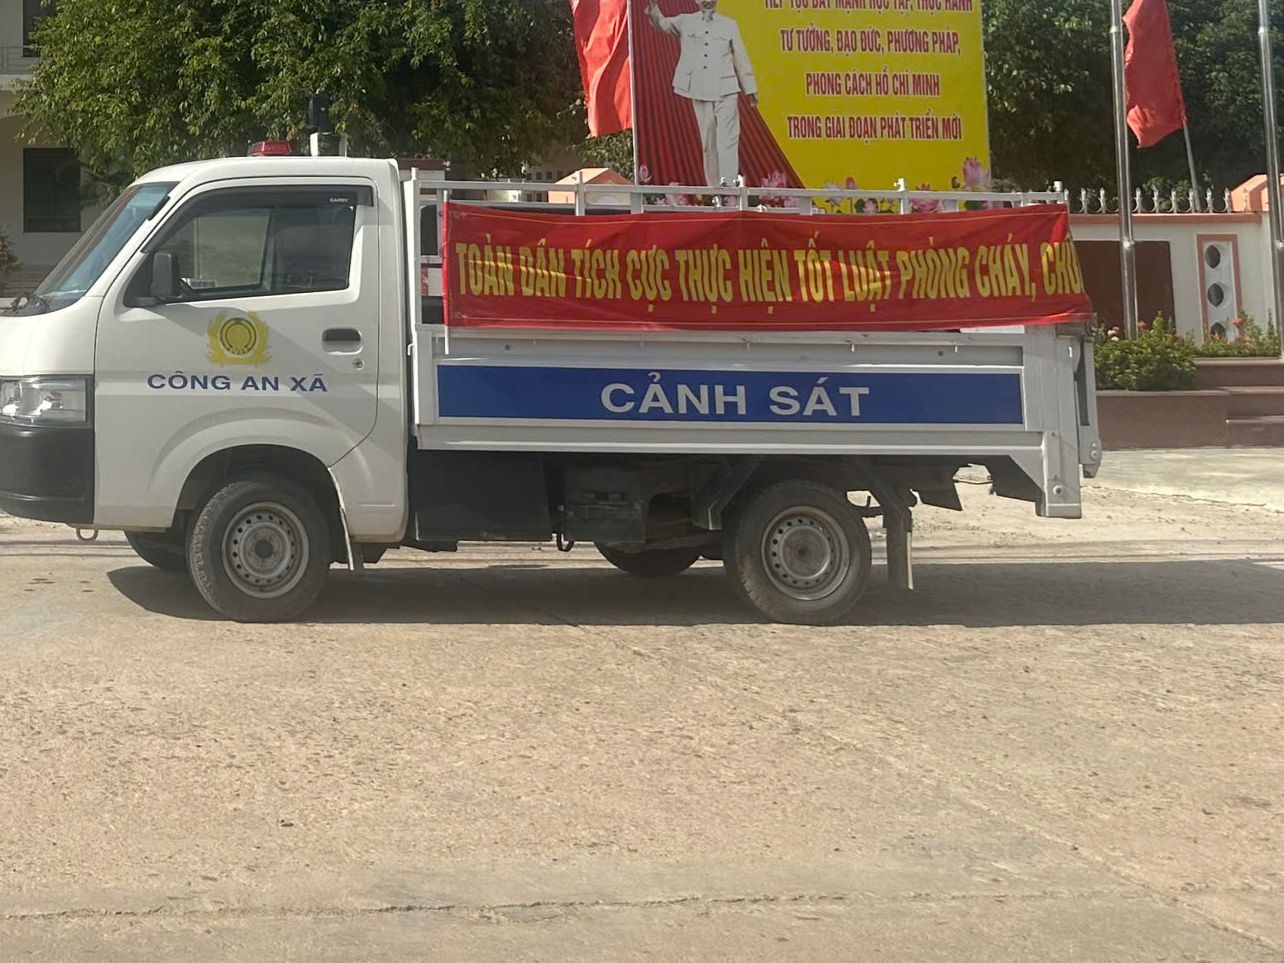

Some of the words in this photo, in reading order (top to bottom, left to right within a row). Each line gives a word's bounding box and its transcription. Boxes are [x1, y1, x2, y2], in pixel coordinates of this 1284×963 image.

[780, 27, 794, 51] TƯ
[796, 22, 833, 54] TƯỞNG,
[836, 30, 857, 57] ĐẠO
[860, 26, 884, 54] ĐỨC,
[887, 28, 929, 52] PHƯƠNG
[932, 27, 961, 55] PHÁP,
[806, 73, 841, 95] PHONG
[845, 68, 872, 95] CÁCH
[892, 69, 909, 95] CHÍ
[912, 73, 940, 96] MINH
[787, 116, 822, 138] TRONG
[825, 116, 846, 138] GIAI
[849, 116, 876, 143] ĐOẠN
[880, 111, 906, 138] PHÁT
[909, 108, 939, 139] TRIỂN
[941, 112, 962, 140] MỚI
[456, 234, 514, 296] TOÀN
[519, 238, 566, 297] DÂN
[571, 239, 622, 299] TÍCH
[626, 245, 672, 312] CỰC
[675, 244, 733, 314] THỰC
[738, 237, 793, 314] HIỆN
[794, 231, 835, 302] TỐT
[839, 240, 891, 312] LUẬT
[896, 237, 970, 299] PHÒNG
[975, 233, 1036, 302] CHÁY,
[147, 370, 231, 390] CÔNG
[241, 375, 279, 391] AN
[290, 373, 328, 392] XÃ
[601, 372, 747, 415] CẢNH
[769, 376, 869, 416] SÁT
